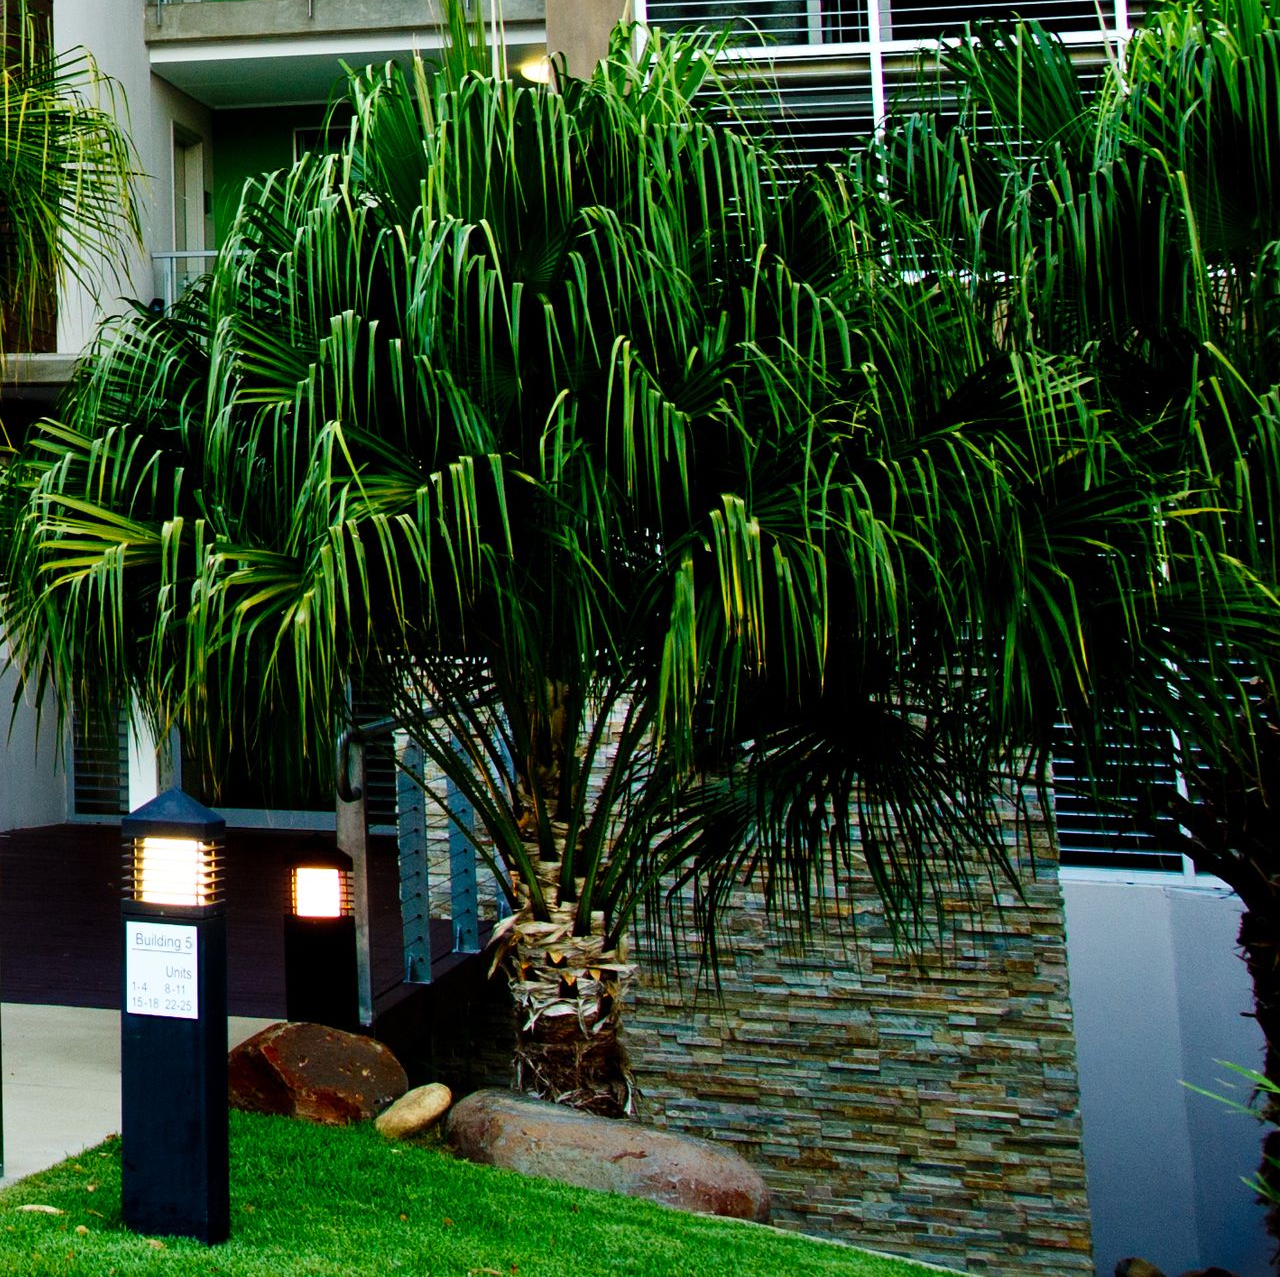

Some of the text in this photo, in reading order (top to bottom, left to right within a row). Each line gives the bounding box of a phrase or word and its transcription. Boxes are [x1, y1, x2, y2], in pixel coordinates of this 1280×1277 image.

[135, 932, 193, 952] Building 5
[165, 966, 192, 980] Units
[132, 996, 192, 1012] 15-18 22-25
